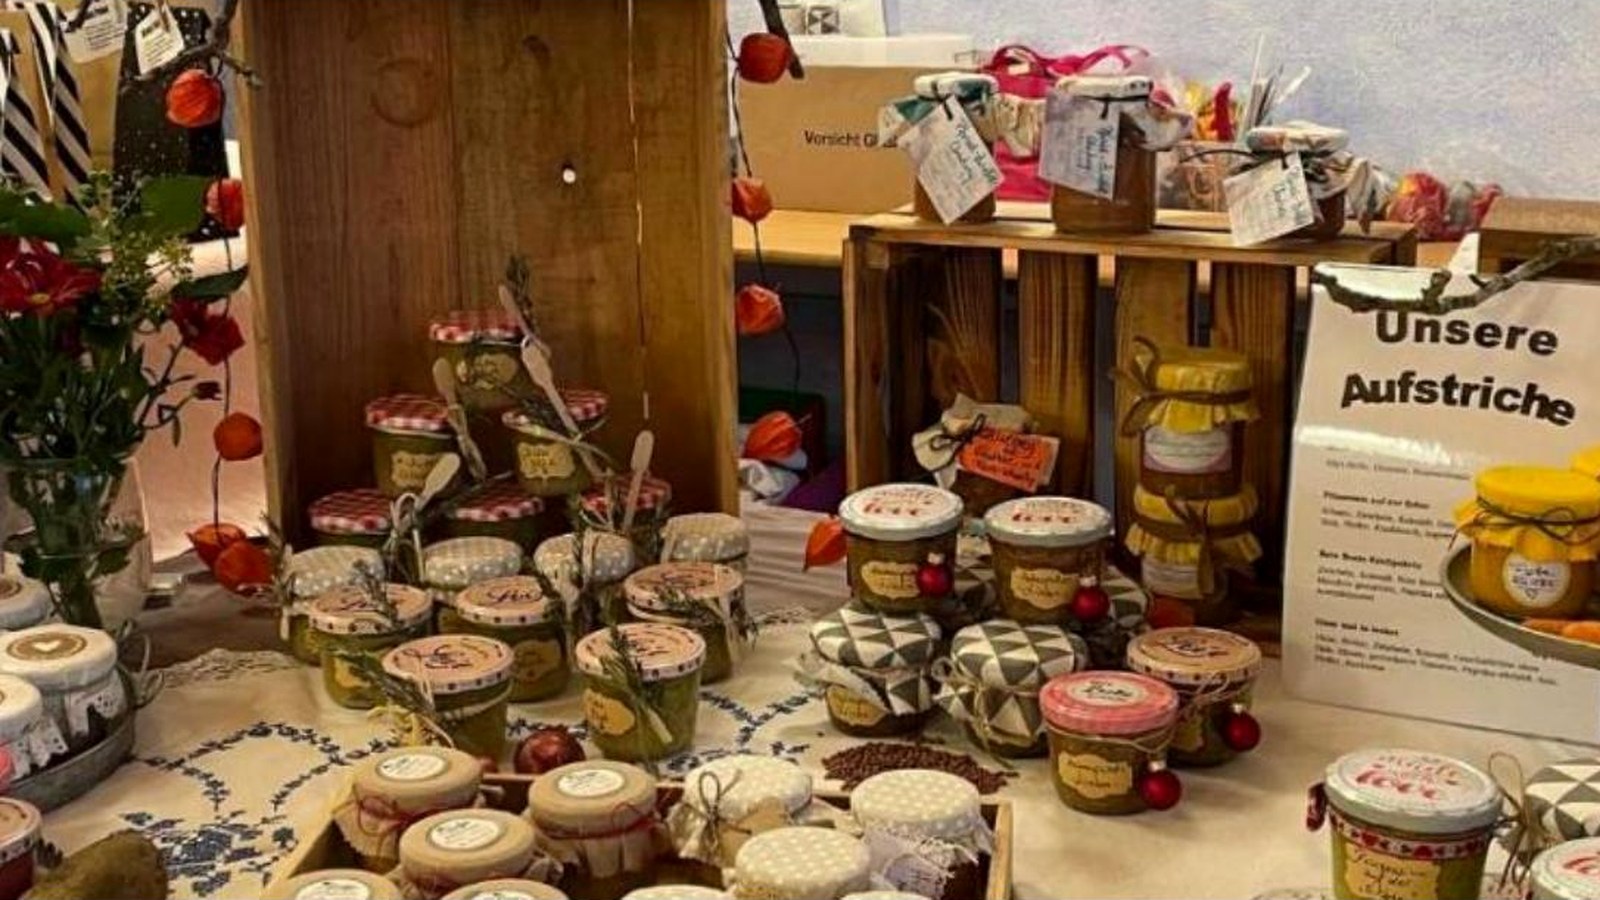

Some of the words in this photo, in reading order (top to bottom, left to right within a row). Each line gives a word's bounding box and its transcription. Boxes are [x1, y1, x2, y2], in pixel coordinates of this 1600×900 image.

[804, 130, 861, 146] Vorsicht
[1376, 308, 1558, 356] Unsere
[1341, 371, 1576, 427] Aufstriche
